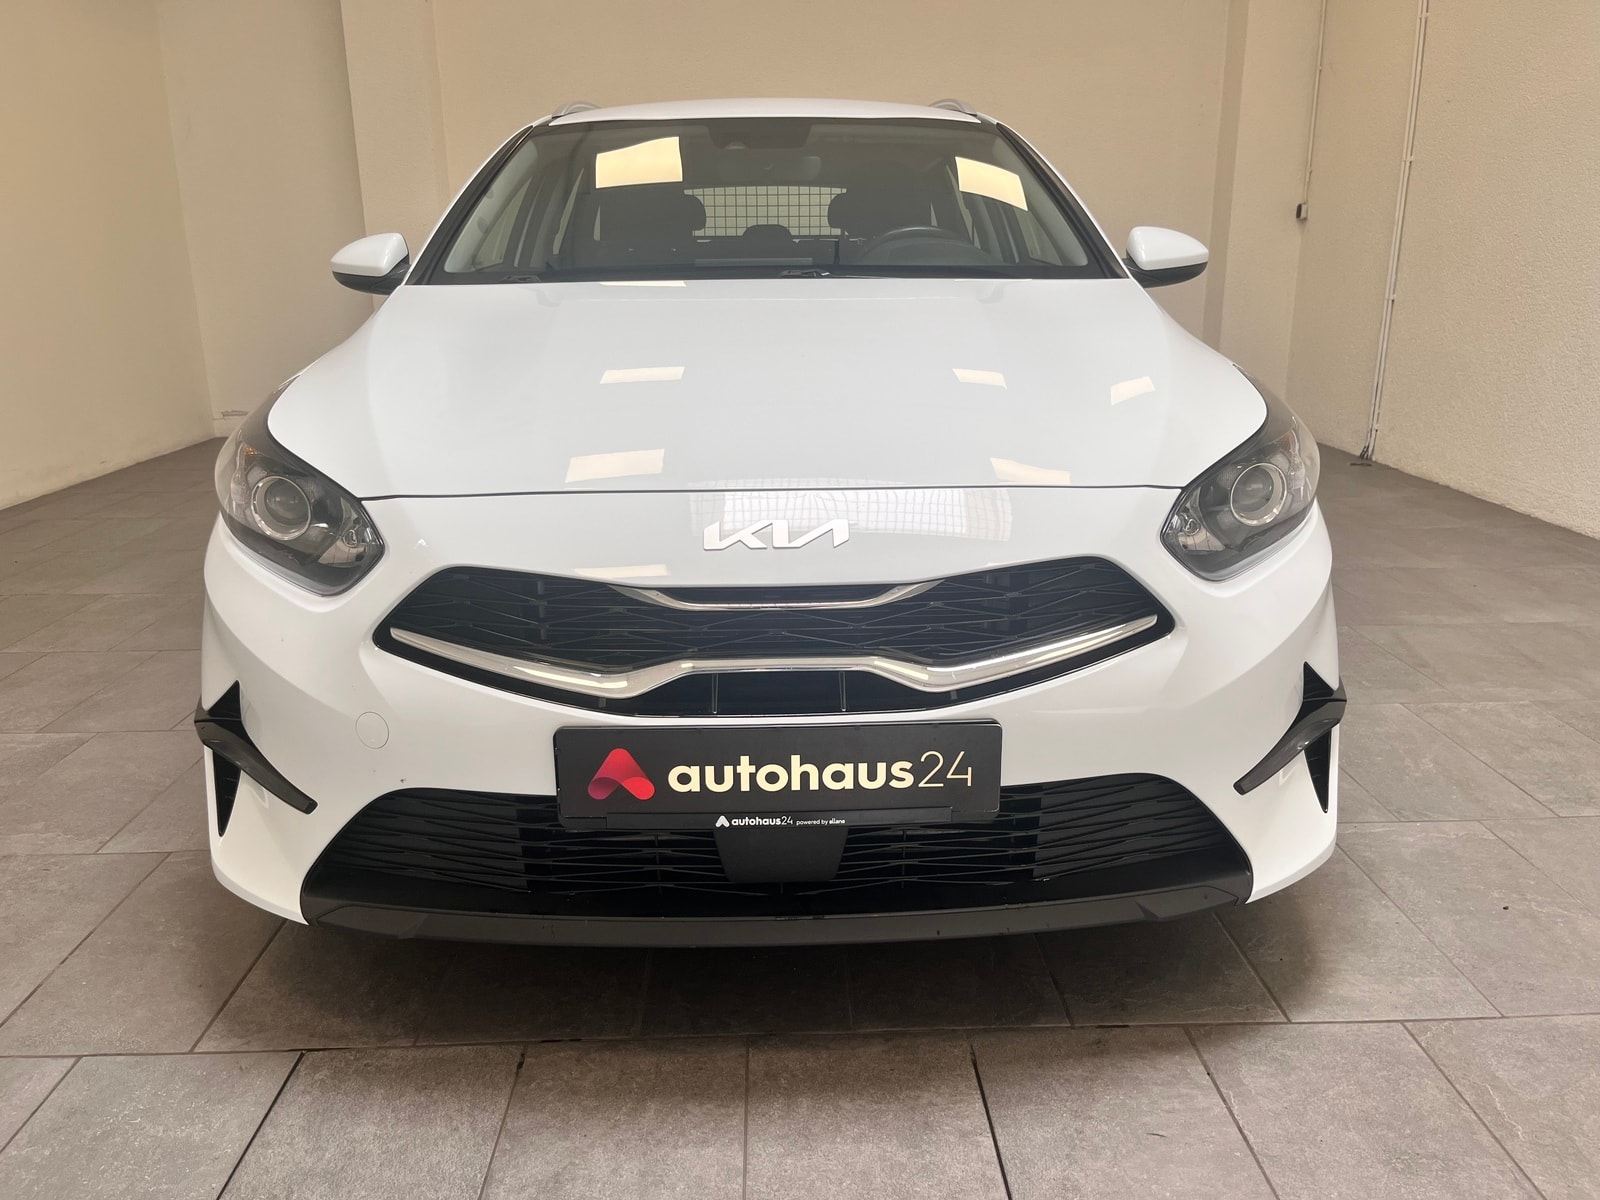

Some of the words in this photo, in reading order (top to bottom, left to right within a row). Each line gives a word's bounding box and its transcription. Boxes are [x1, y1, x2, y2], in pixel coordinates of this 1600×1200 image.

[703, 519, 850, 551] KIA
[667, 750, 973, 794] autohaus24
[731, 815, 793, 826] autohaus24
[796, 818, 820, 826] powered
